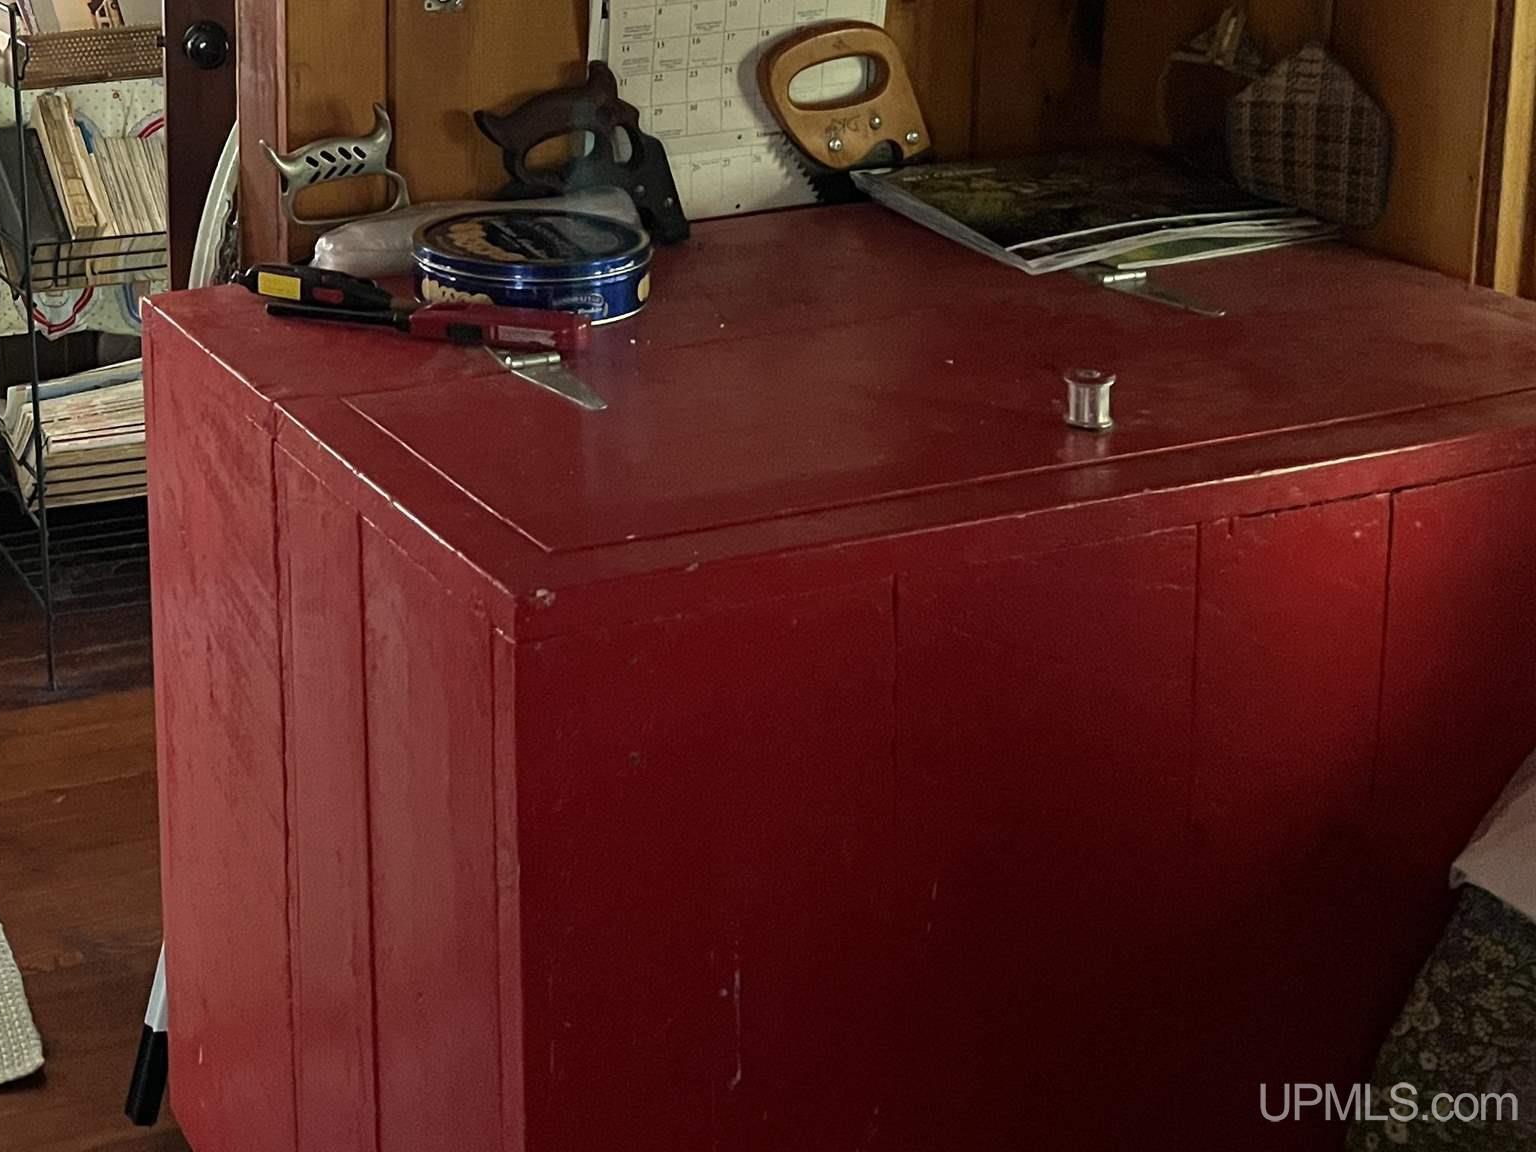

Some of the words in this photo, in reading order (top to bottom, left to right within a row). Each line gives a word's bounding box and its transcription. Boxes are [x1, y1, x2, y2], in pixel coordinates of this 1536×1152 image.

[691, 37, 702, 46] 16
[726, 32, 737, 41] 17
[689, 70, 699, 79] 23
